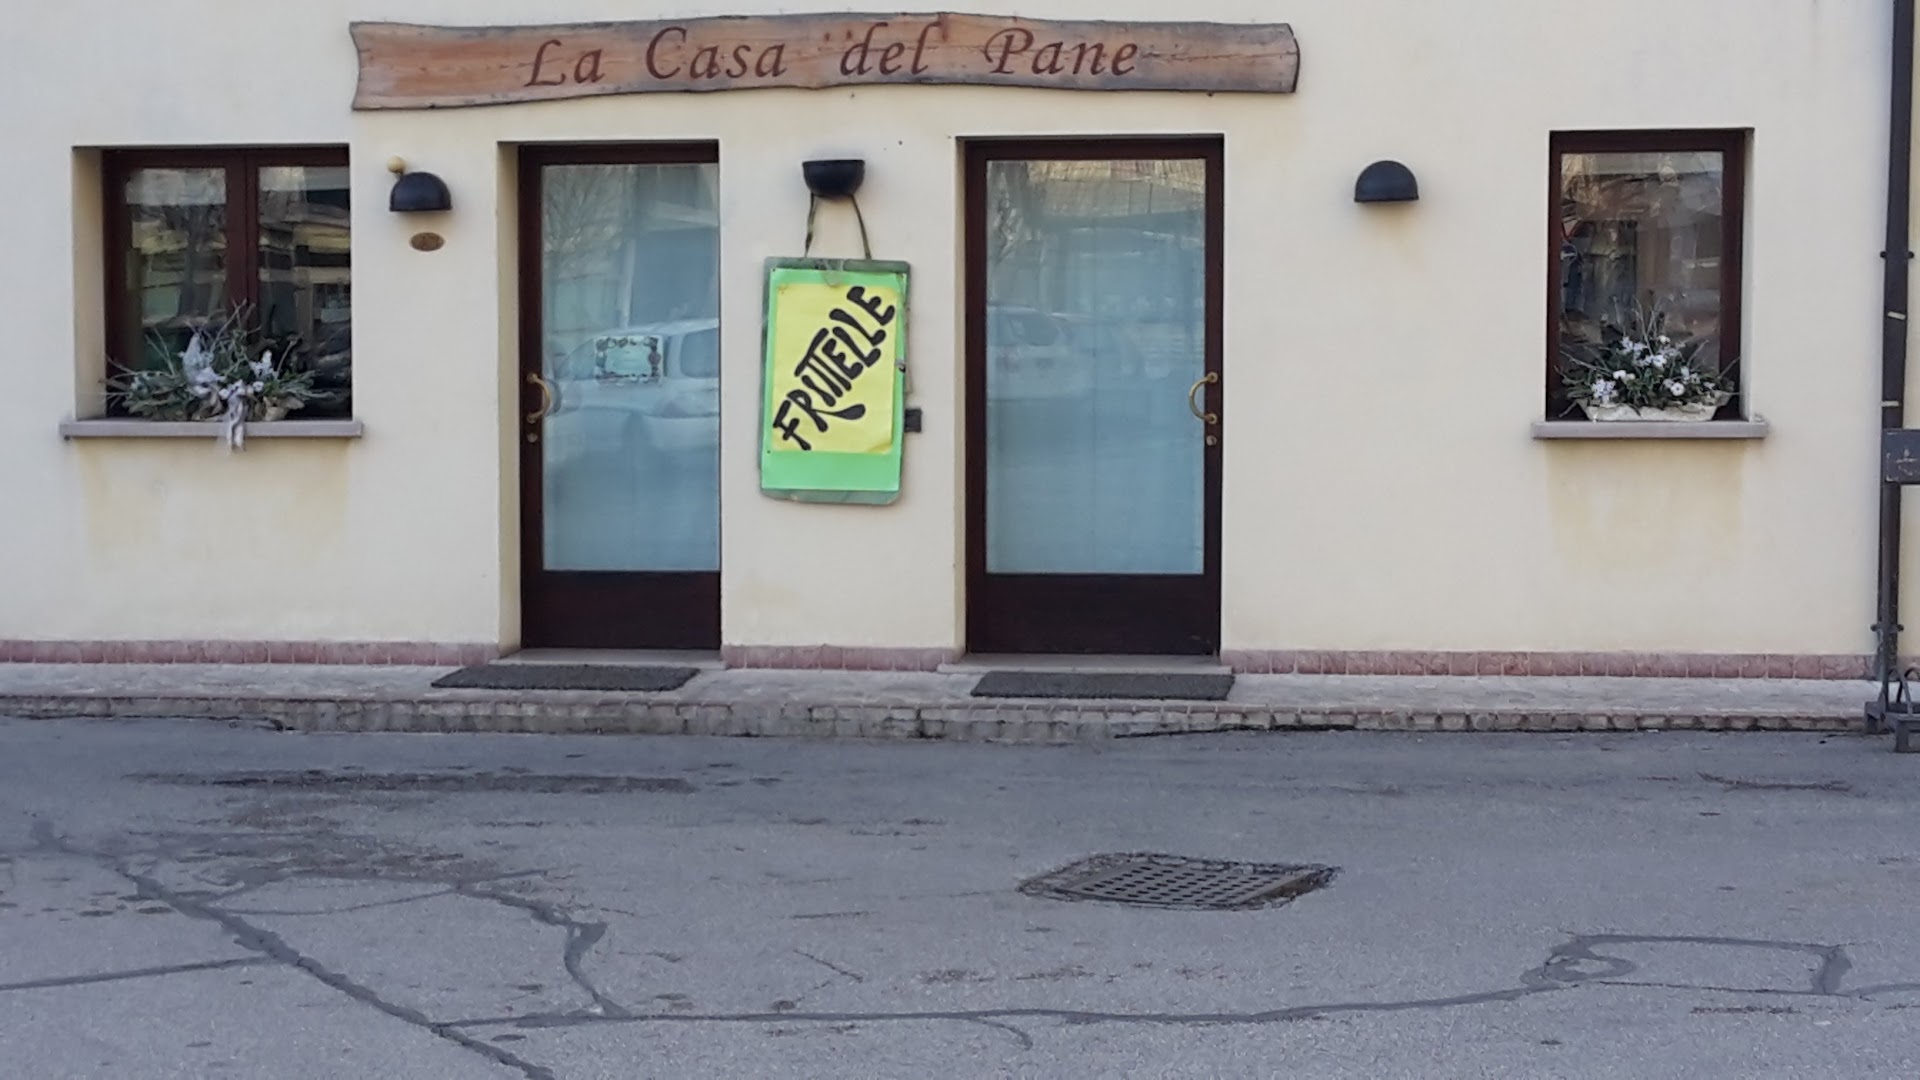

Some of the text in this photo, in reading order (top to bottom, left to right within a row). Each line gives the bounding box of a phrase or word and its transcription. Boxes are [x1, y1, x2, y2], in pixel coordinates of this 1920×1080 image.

[524, 22, 1139, 87] La Casa del Pane
[772, 286, 896, 451] FRITTELLE
